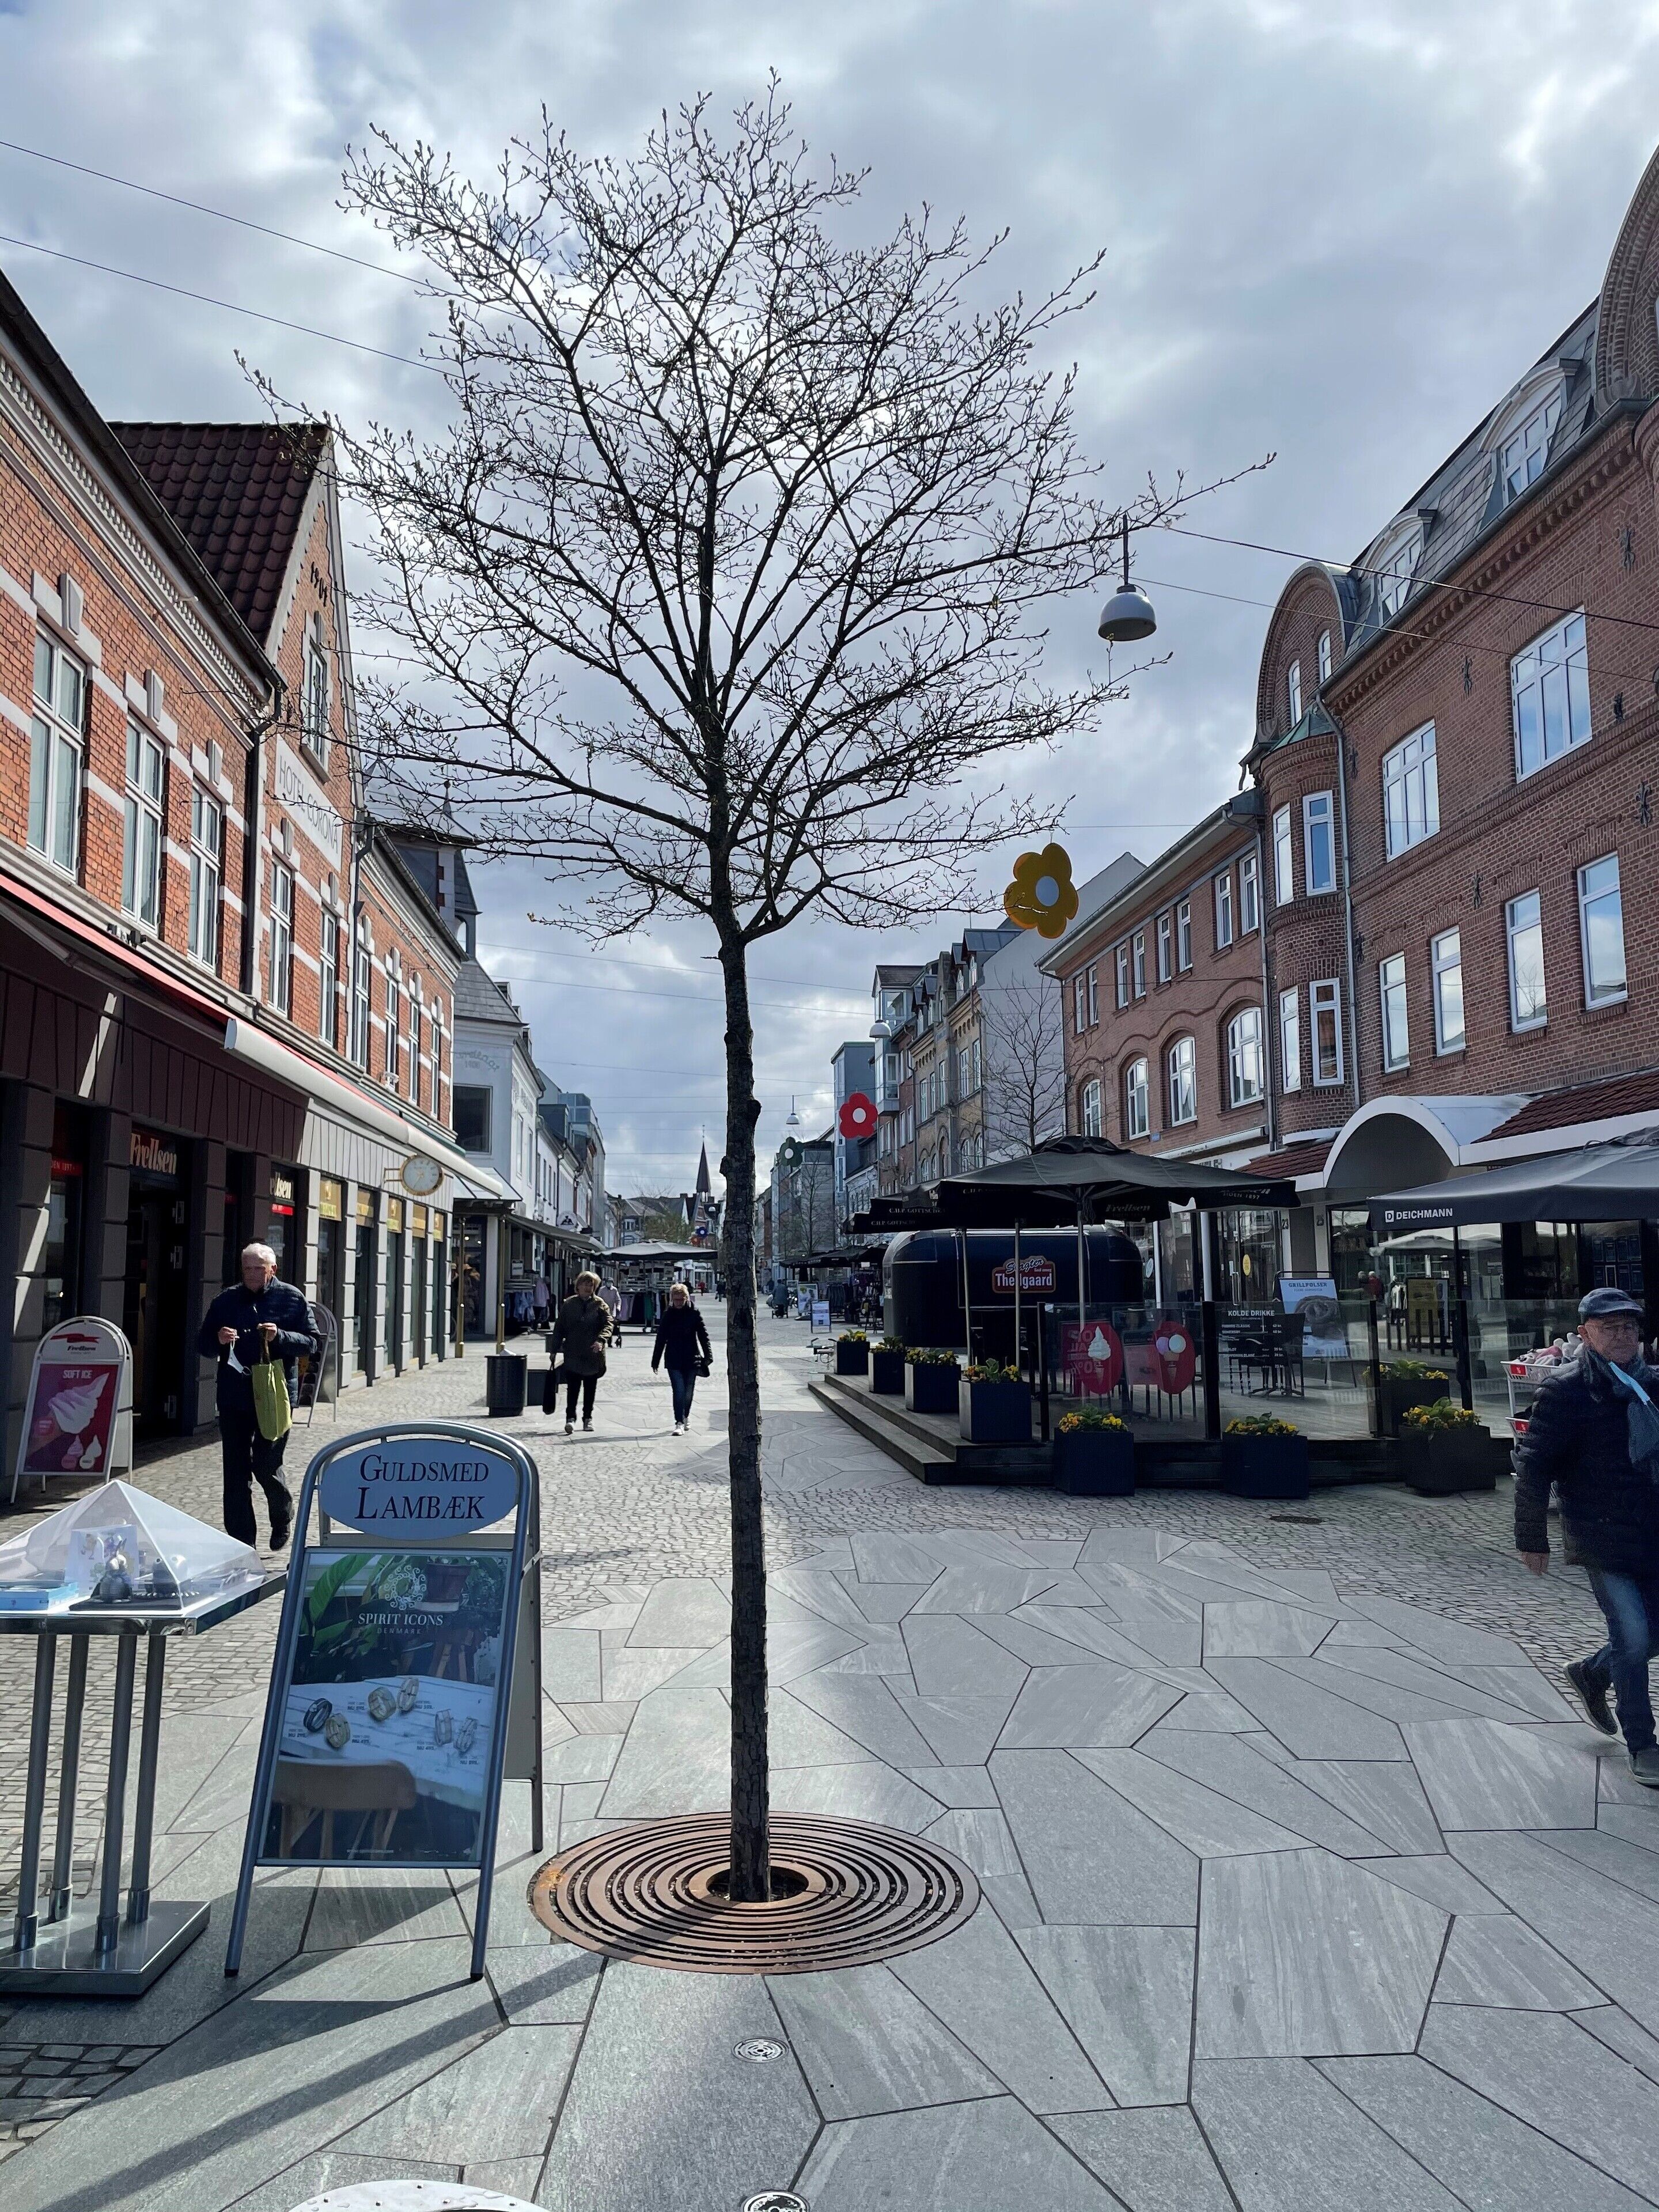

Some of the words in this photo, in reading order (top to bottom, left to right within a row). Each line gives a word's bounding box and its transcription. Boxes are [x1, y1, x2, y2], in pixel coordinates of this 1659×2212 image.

[279, 755, 305, 813] HOTEL
[307, 793, 339, 854] CORONA
[130, 1132, 177, 1175] Frellsen
[1396, 1208, 1453, 1220] DEICHMANN
[1005, 1258, 1045, 1274] Sagter
[995, 1272, 1052, 1289] Thelgaard
[63, 1370, 80, 1378] SOFT
[81, 1370, 93, 1378] ICE
[360, 1454, 489, 1482] GULDSMED
[354, 1487, 485, 1519] LAMBÆK
[358, 1613, 401, 1625] SPIRIT
[404, 1614, 444, 1626] ICONS
